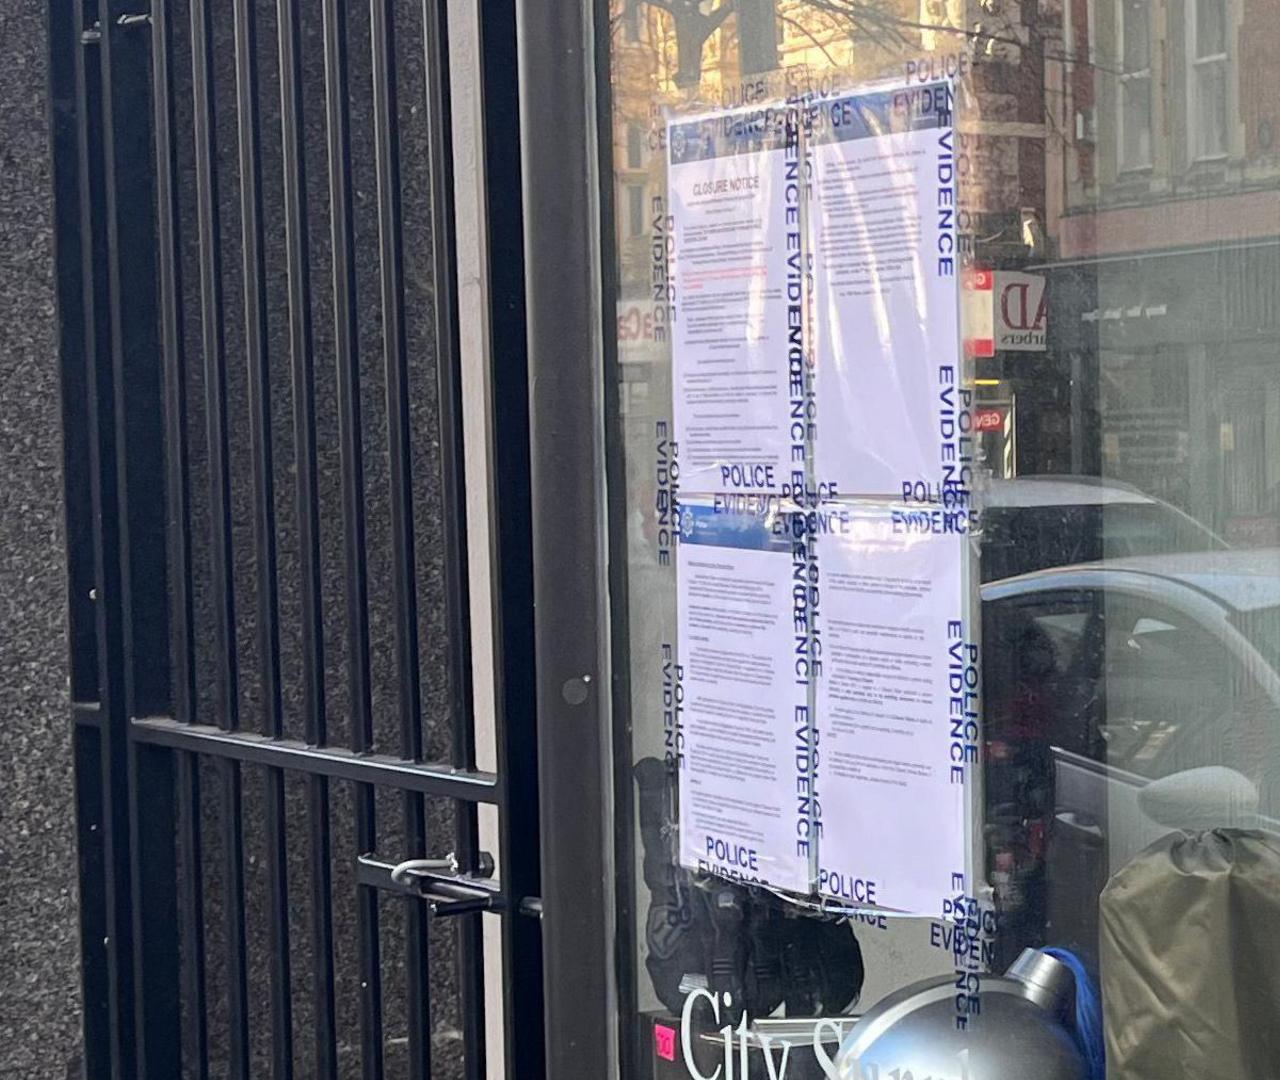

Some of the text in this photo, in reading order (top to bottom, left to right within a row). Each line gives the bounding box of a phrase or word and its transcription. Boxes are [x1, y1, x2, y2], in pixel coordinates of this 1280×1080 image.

[905, 51, 969, 85] POLICE
[692, 176, 760, 197] CLOSURE NOTICE
[938, 110, 953, 277] EVIDENCE
[652, 196, 666, 342] EVIDENCE
[720, 464, 776, 489] POLICE
[947, 620, 965, 785] EVIDENCE
[964, 645, 979, 764] POLICE
[794, 705, 810, 858] EVIDENCE
[705, 836, 760, 872] POLICE
[820, 869, 876, 905] POLICE
